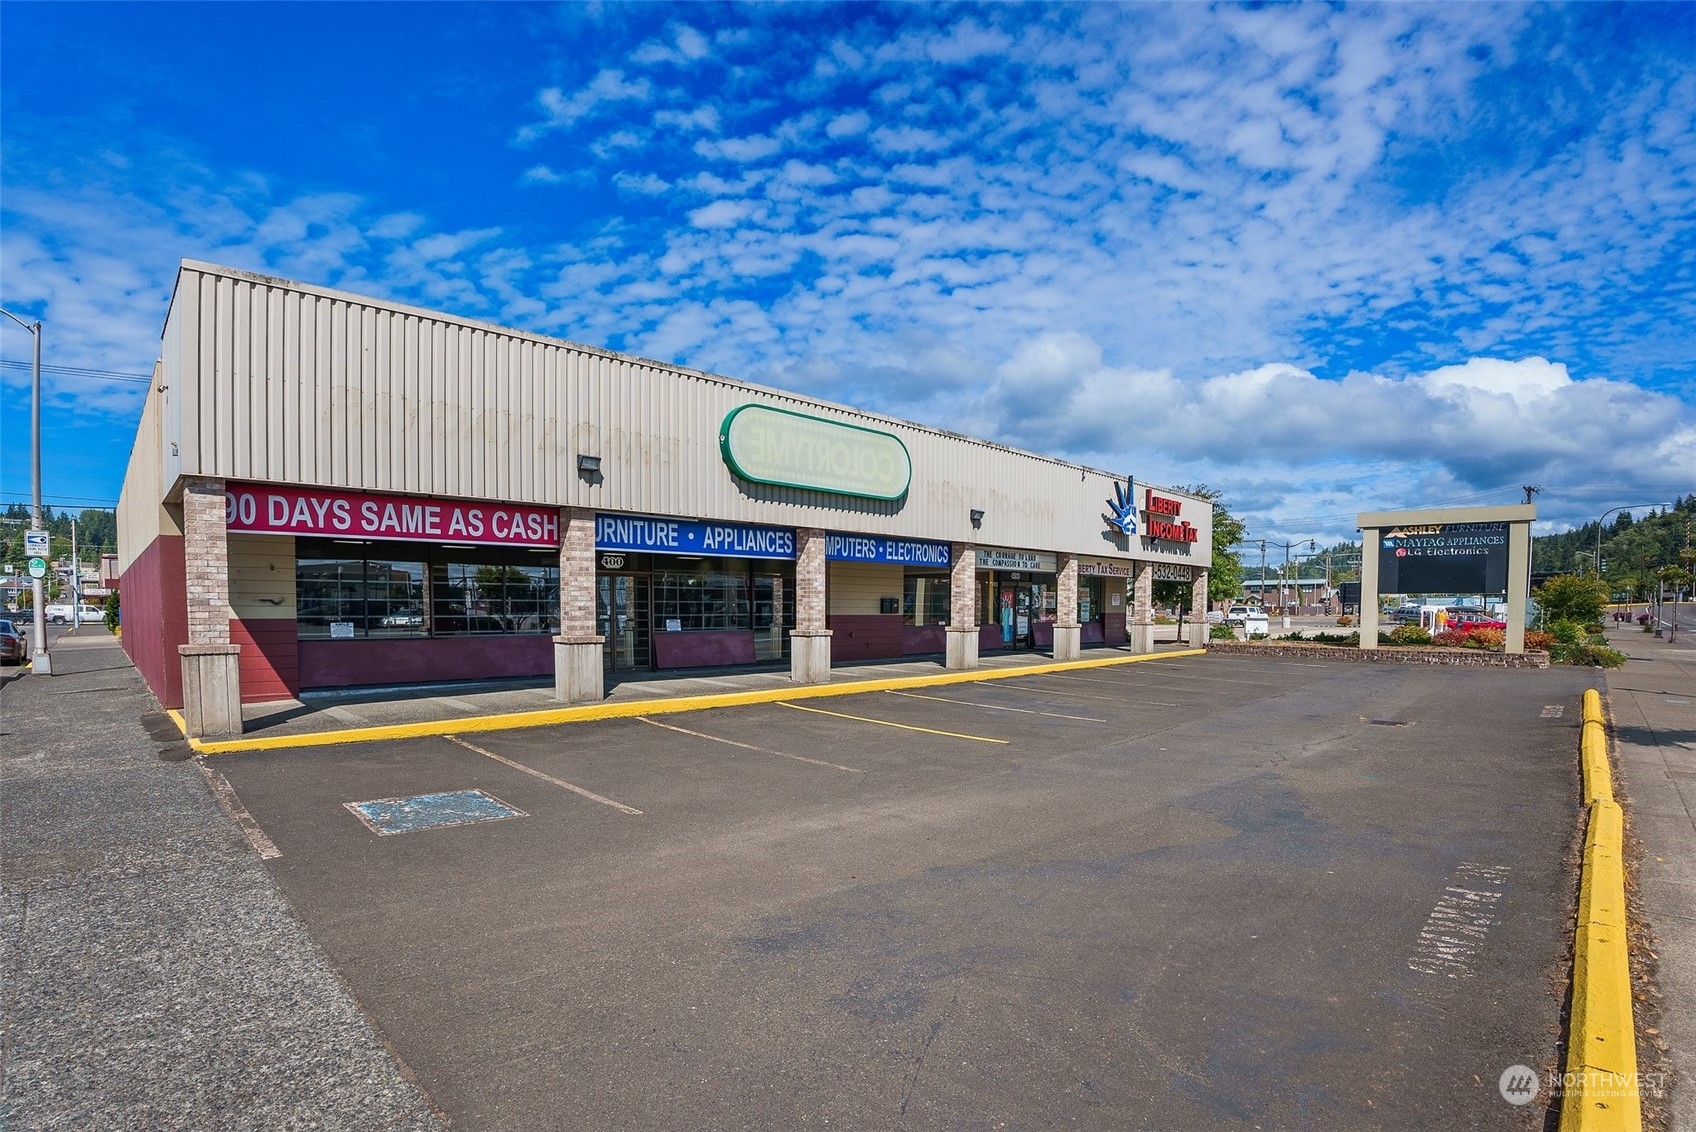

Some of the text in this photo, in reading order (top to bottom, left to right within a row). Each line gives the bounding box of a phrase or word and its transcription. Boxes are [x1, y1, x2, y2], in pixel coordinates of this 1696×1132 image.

[1145, 489, 1181, 516] LIBERTY
[226, 492, 558, 541] 90 DAYS SAME AS CASH
[703, 527, 792, 554] APPLIANCES
[1395, 536, 1505, 548] MAYTAG APPLIANCES
[886, 541, 949, 563] ELECTRONICS
[995, 552, 1016, 560] COURAGE
[1427, 547, 1490, 555] Electronics
[602, 557, 623, 568] 400
[979, 558, 989, 566] THE
[992, 559, 1020, 568] COMPASSION
[1022, 561, 1028, 569] TO
[1096, 562, 1108, 575] TAX
[1108, 563, 1130, 576] SERVICE
